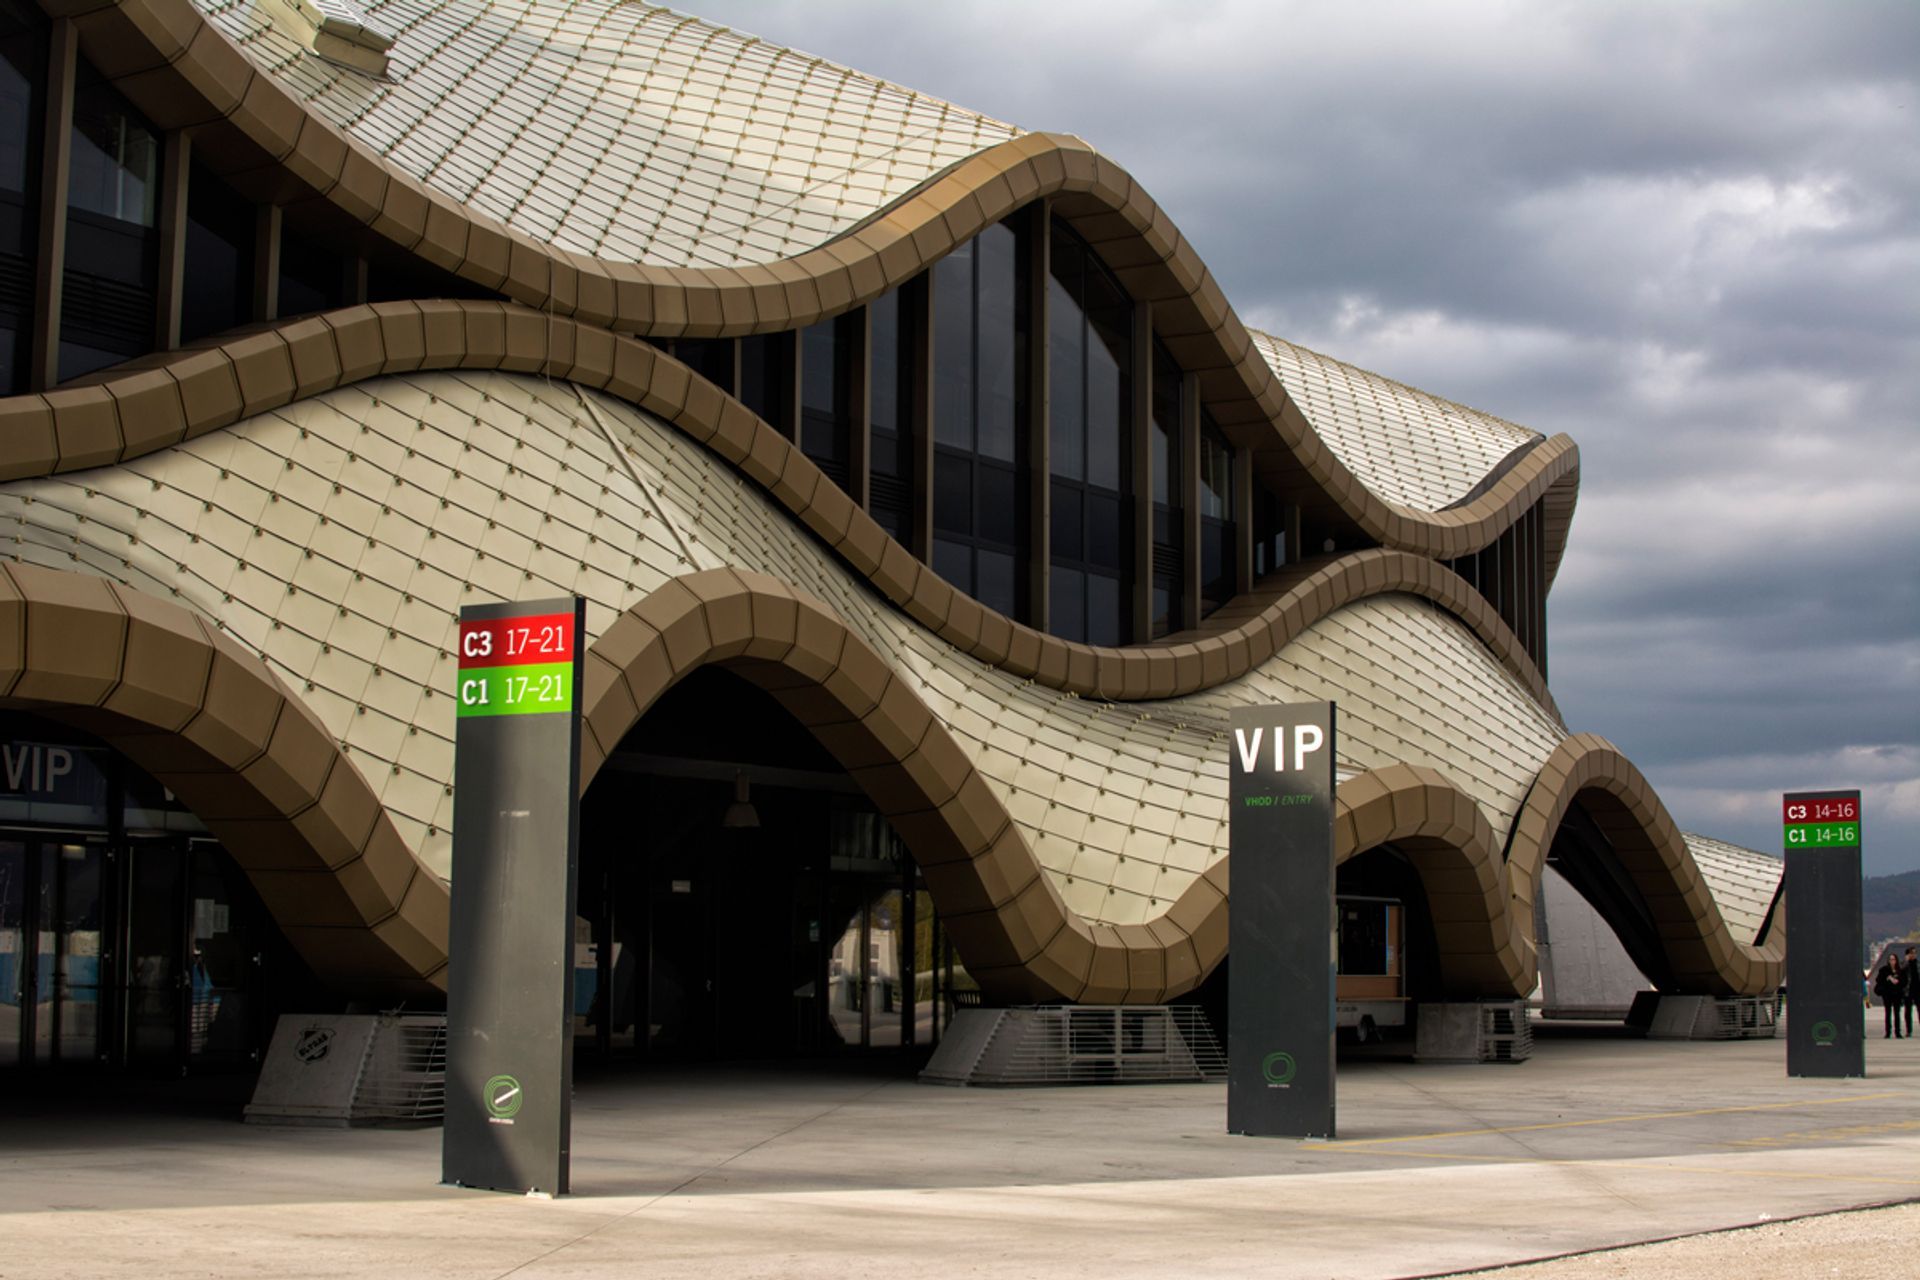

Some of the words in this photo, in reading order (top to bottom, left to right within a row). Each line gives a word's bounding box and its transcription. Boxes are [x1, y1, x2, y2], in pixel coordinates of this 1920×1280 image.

[464, 631, 492, 657] C3
[506, 626, 565, 655] 17-21
[462, 679, 489, 705] C1
[505, 674, 563, 704] 17-21
[1235, 724, 1323, 773] VIP
[2, 744, 73, 792] VIP
[1244, 796, 1272, 806] VHOD
[1281, 794, 1313, 805] ENTRY
[1788, 805, 1807, 819] C3
[1815, 803, 1854, 819] 14-16
[1788, 829, 1807, 842] C1
[1816, 827, 1855, 842] 14-16
